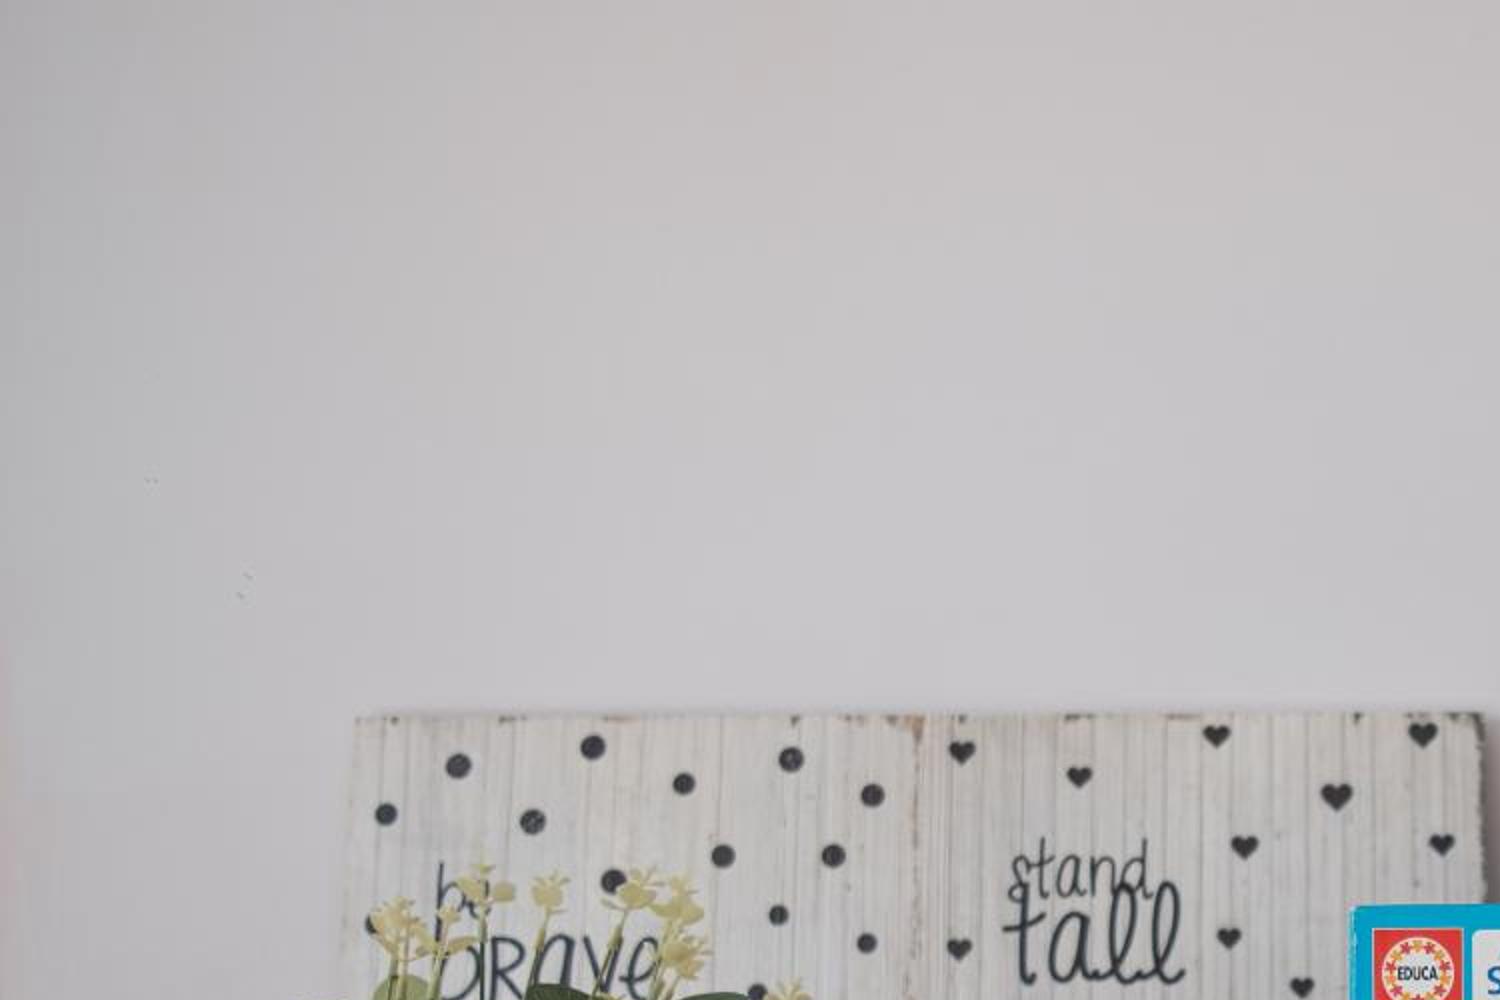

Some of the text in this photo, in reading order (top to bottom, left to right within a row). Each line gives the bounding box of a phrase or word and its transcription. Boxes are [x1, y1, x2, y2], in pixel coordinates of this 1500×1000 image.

[1007, 836, 1154, 902] stand
[1002, 880, 1186, 985] tall
[1397, 965, 1439, 981] EDUCA
